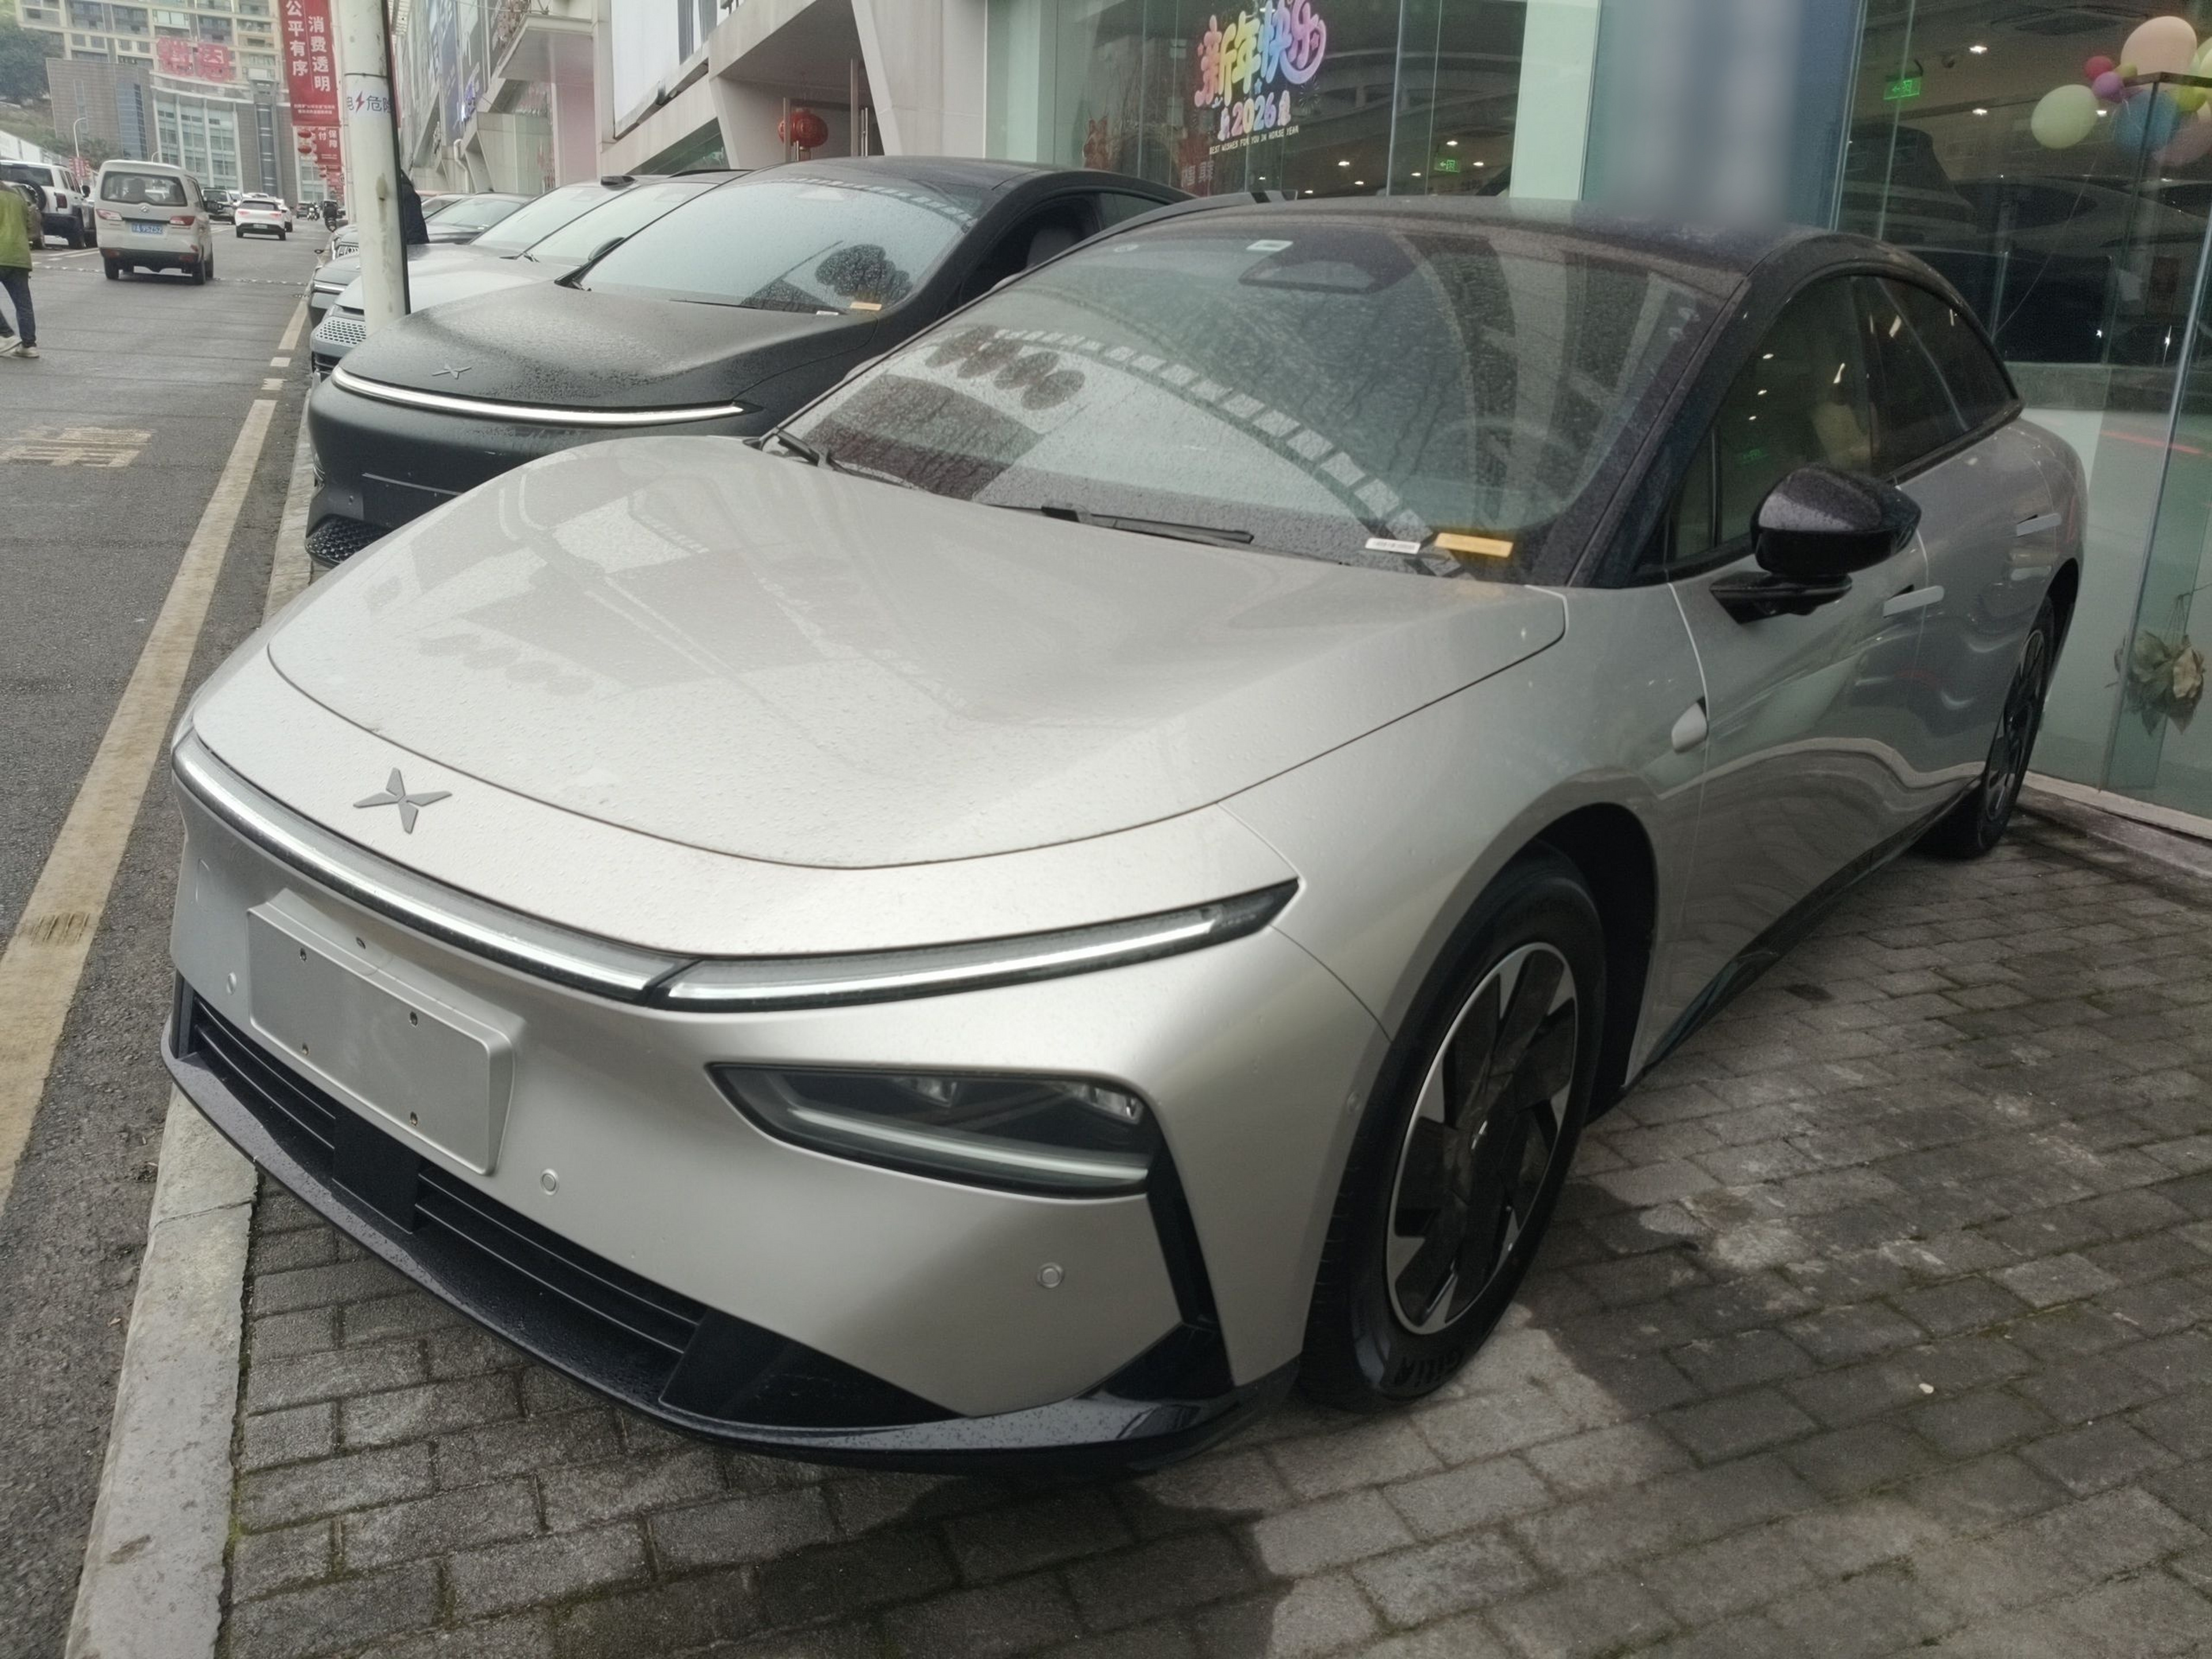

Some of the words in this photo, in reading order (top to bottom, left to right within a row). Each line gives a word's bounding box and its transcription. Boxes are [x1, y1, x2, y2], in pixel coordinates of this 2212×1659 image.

[286, 1, 308, 77] 公平有序
[308, 16, 331, 92] 消费透明
[1194, 0, 1327, 107] 新年快乐
[1209, 145, 1221, 155] BEST
[1222, 140, 1238, 151] WISHES
[1240, 137, 1249, 147] FOR
[1251, 135, 1260, 143] YOU
[1261, 134, 1267, 142] IN
[1268, 128, 1285, 139] HORSE
[1286, 125, 1299, 136] YEAR
[1231, 92, 1277, 137] 2026
